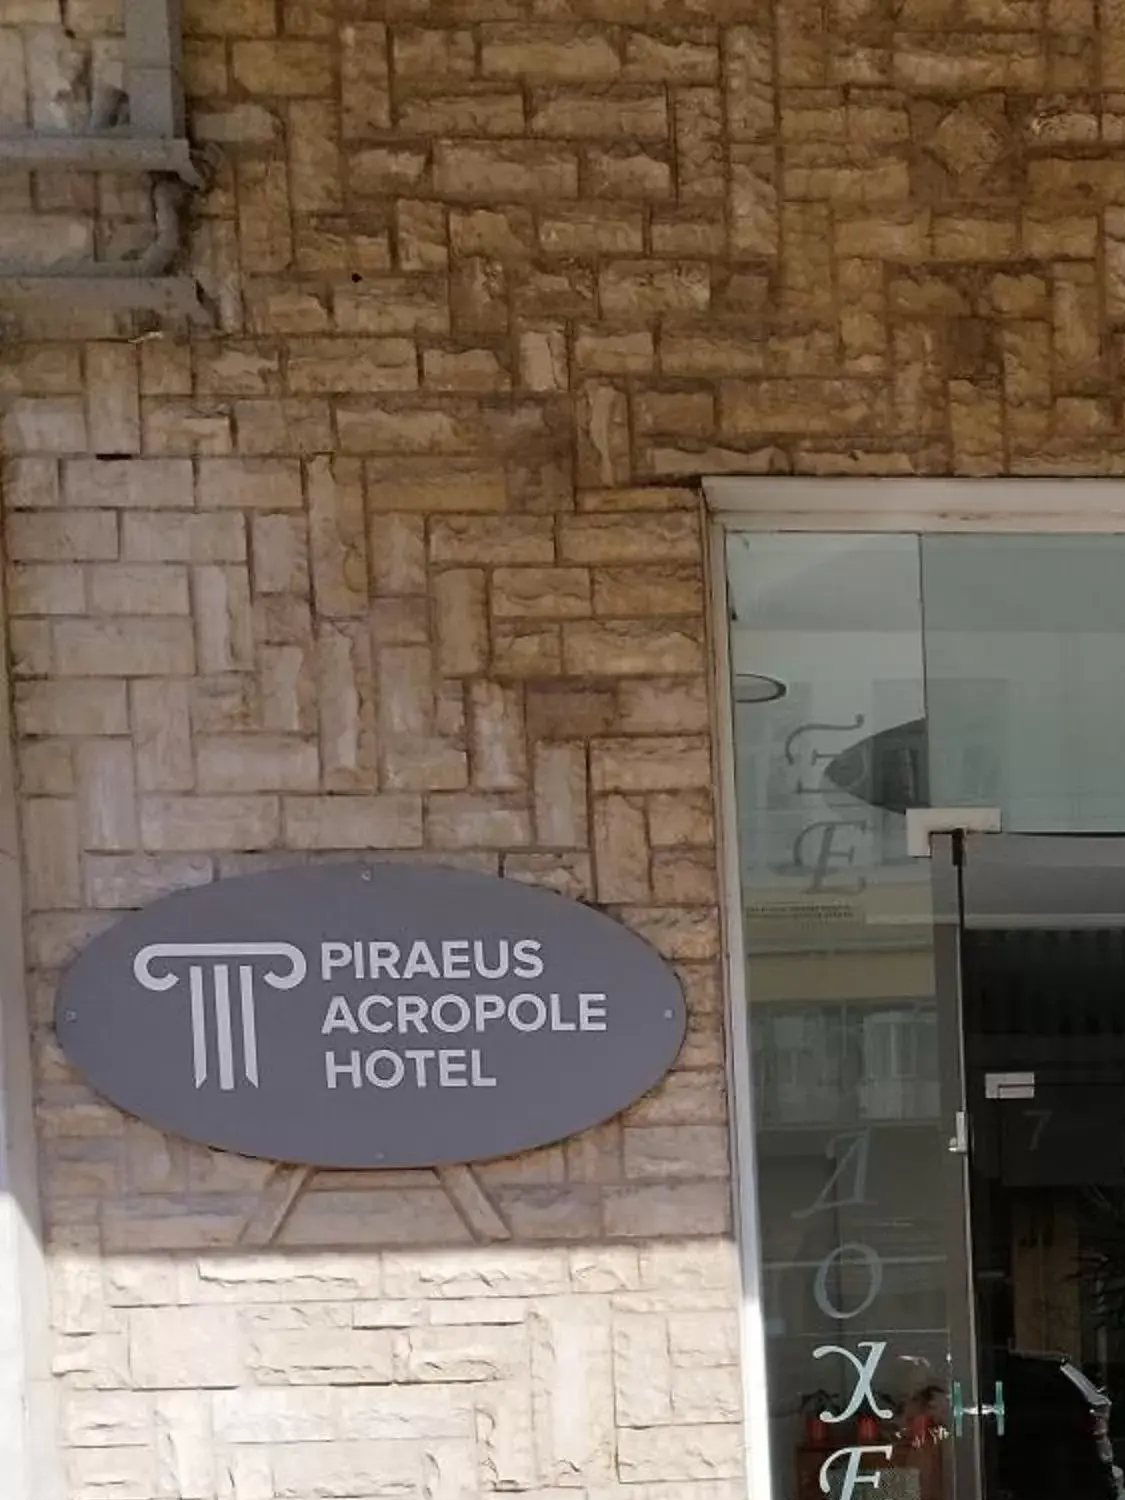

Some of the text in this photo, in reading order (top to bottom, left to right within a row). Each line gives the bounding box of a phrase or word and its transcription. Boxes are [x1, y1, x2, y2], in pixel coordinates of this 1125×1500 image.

[321, 938, 545, 980] PIRAEUS
[321, 993, 608, 1034] ACROPOLE
[325, 1048, 498, 1089] HOTEL
